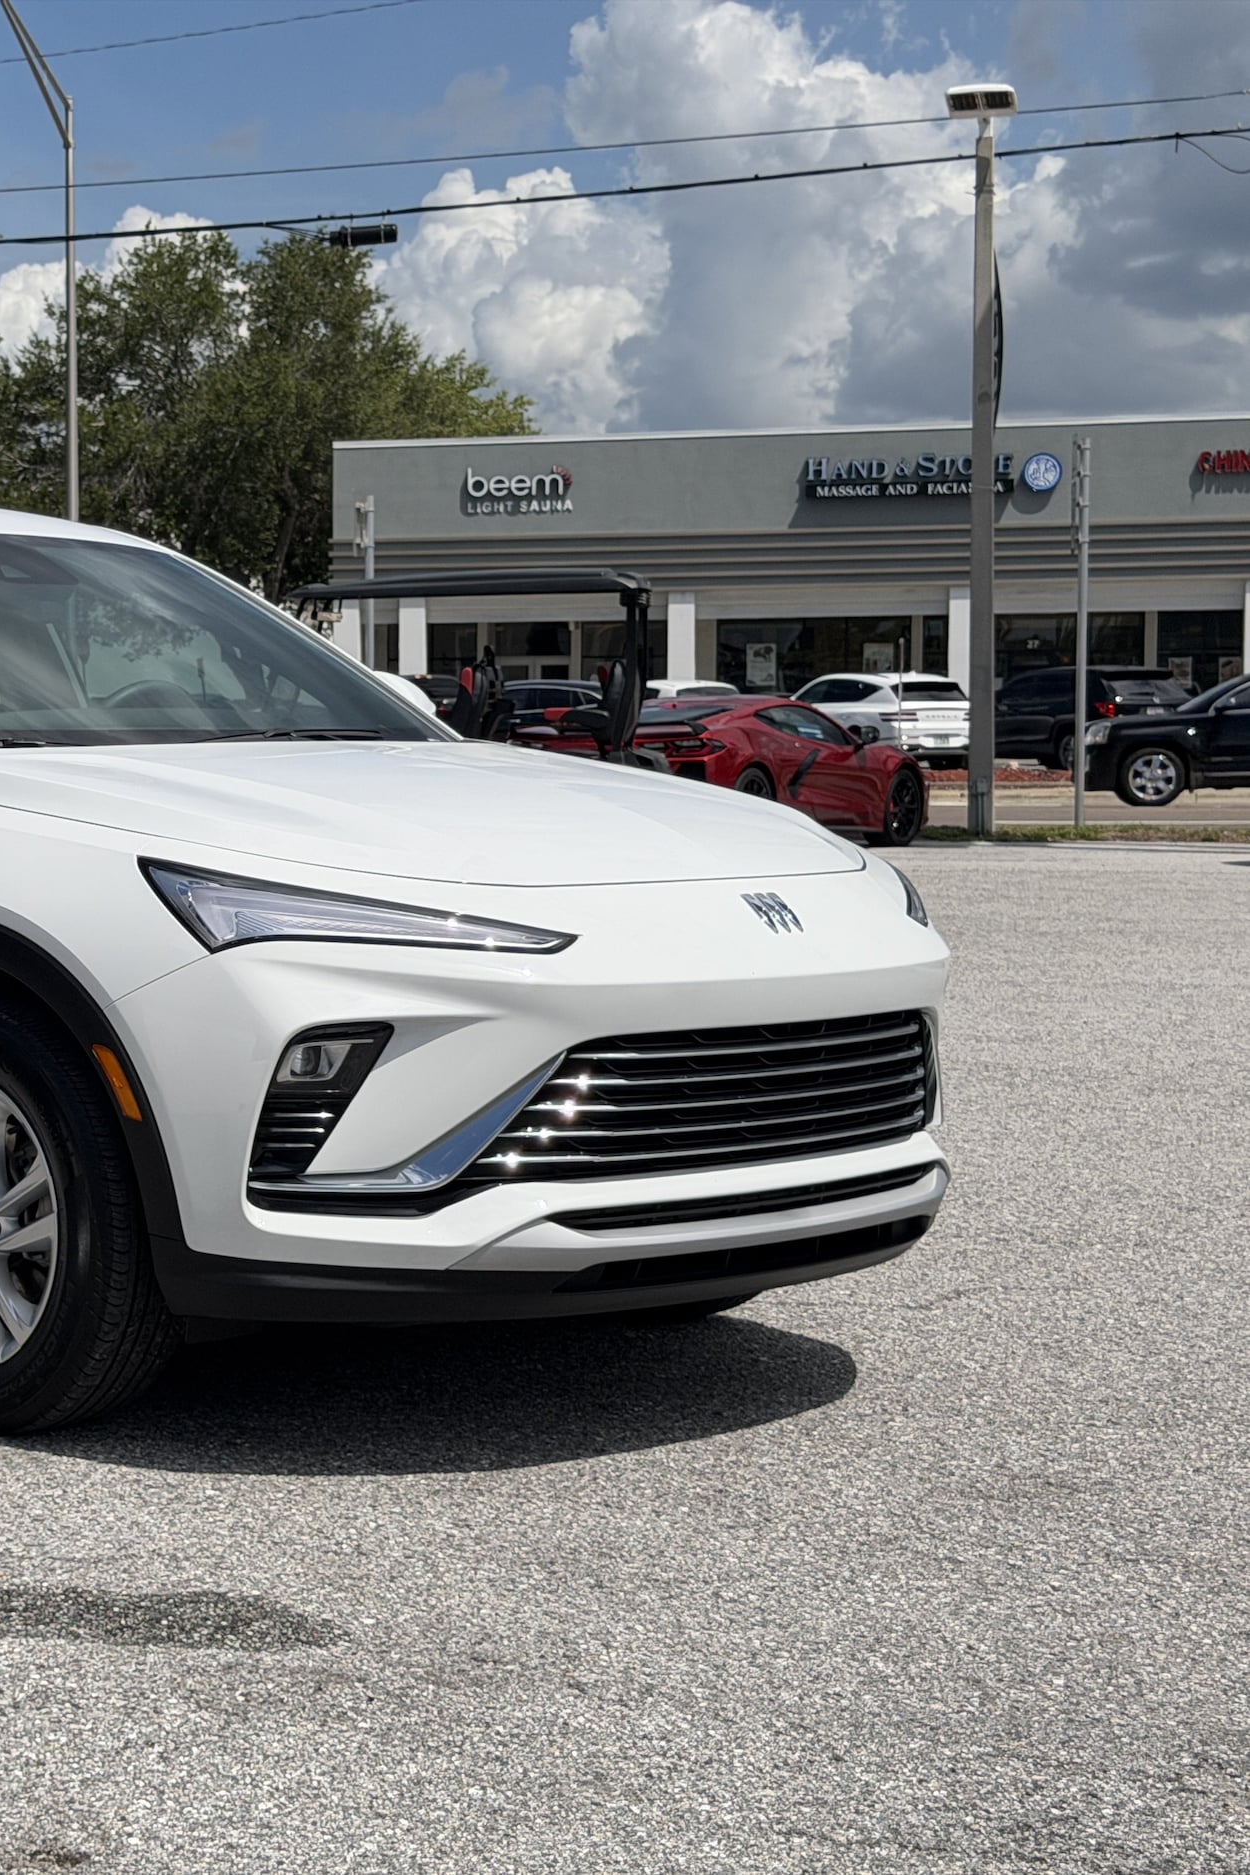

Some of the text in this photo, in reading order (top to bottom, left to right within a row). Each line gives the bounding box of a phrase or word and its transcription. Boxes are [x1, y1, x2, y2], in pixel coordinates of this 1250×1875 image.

[807, 455, 1012, 480] HAND & STOE
[467, 467, 565, 497] beem
[816, 485, 880, 497] MASSAGE
[885, 484, 918, 496] AND
[467, 499, 573, 513] LIGHT SAUNA
